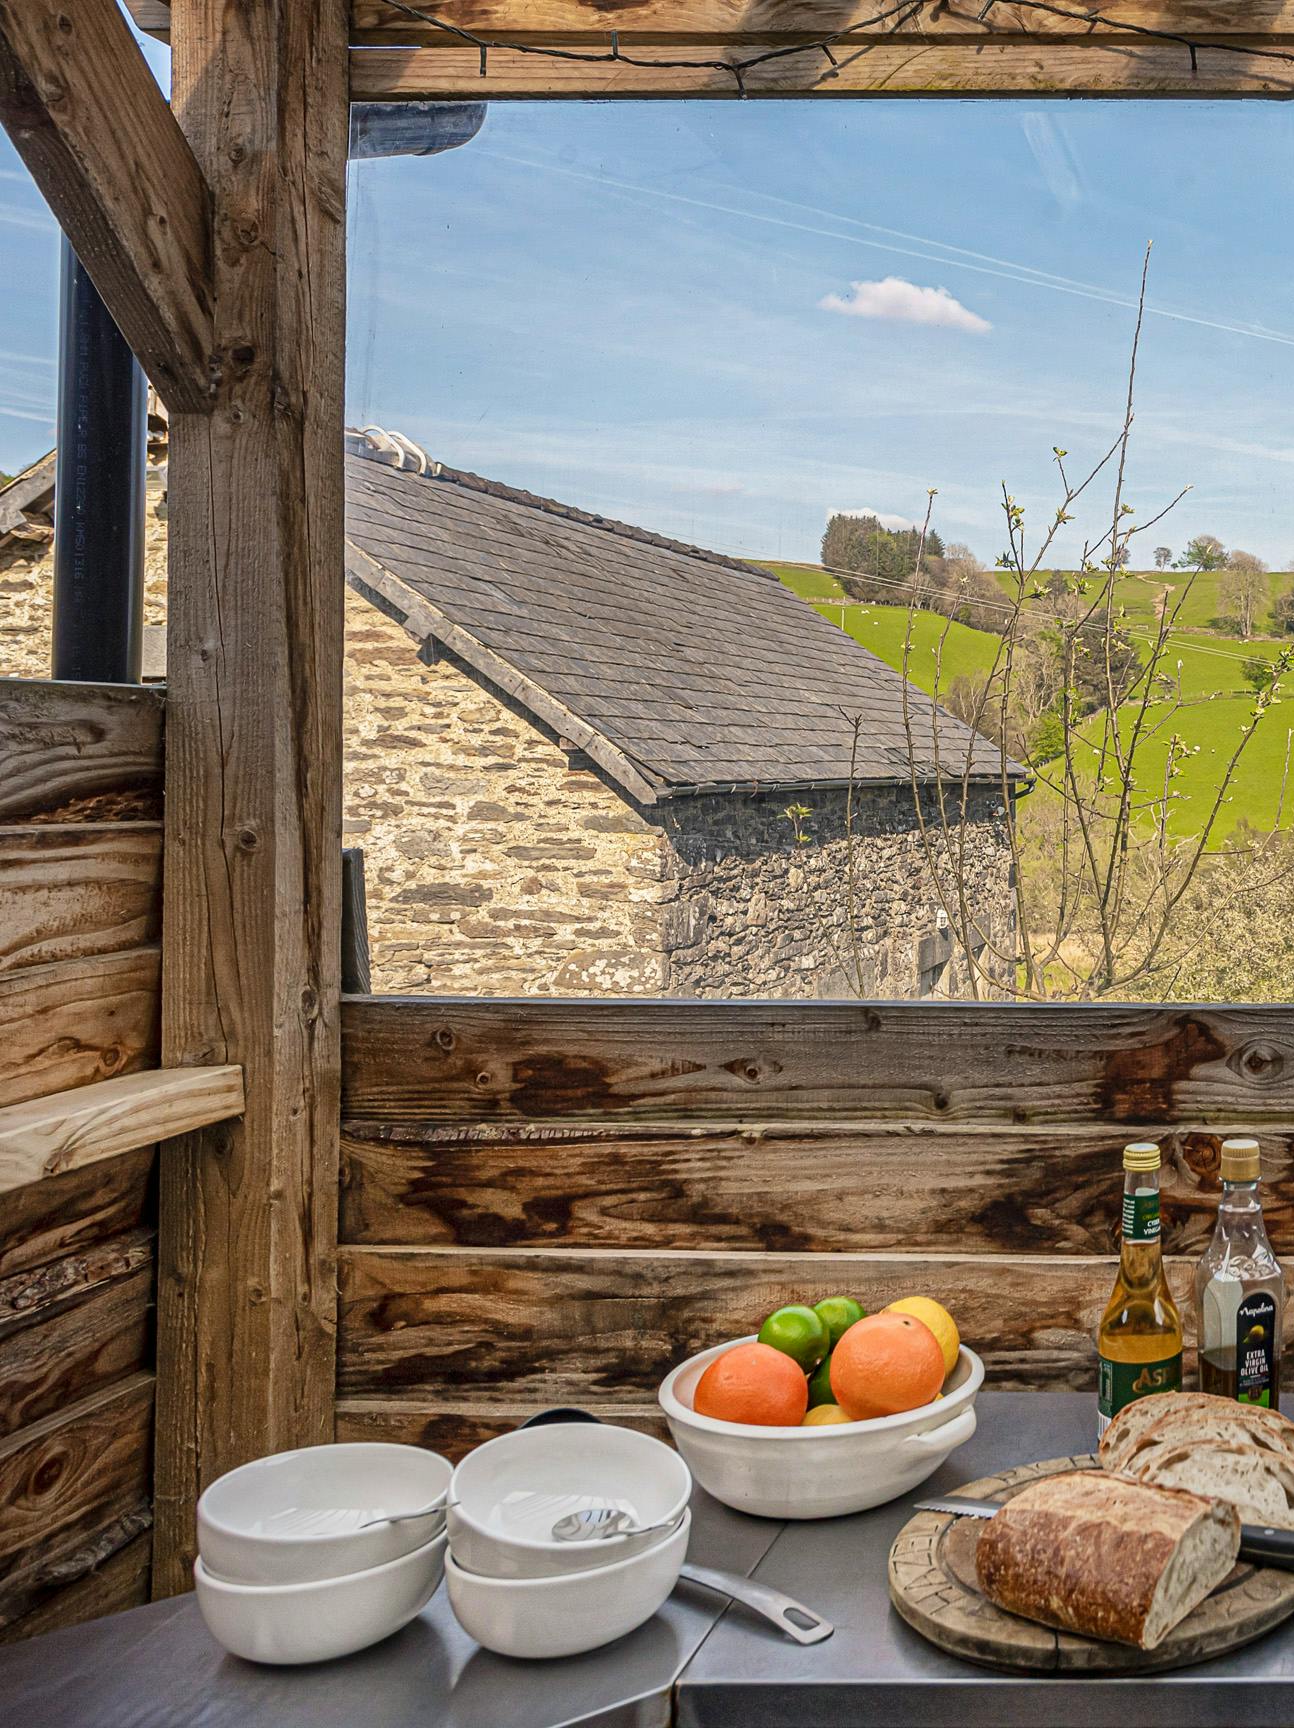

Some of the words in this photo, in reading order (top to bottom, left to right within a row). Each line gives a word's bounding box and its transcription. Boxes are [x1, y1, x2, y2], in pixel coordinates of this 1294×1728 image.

[1239, 1302, 1273, 1317] Napolina
[1246, 1348, 1265, 1359] EXTRA
[1245, 1357, 1266, 1367] VIRGIN
[1240, 1366, 1258, 1376] OLIVE
[1259, 1364, 1268, 1373] OIL
